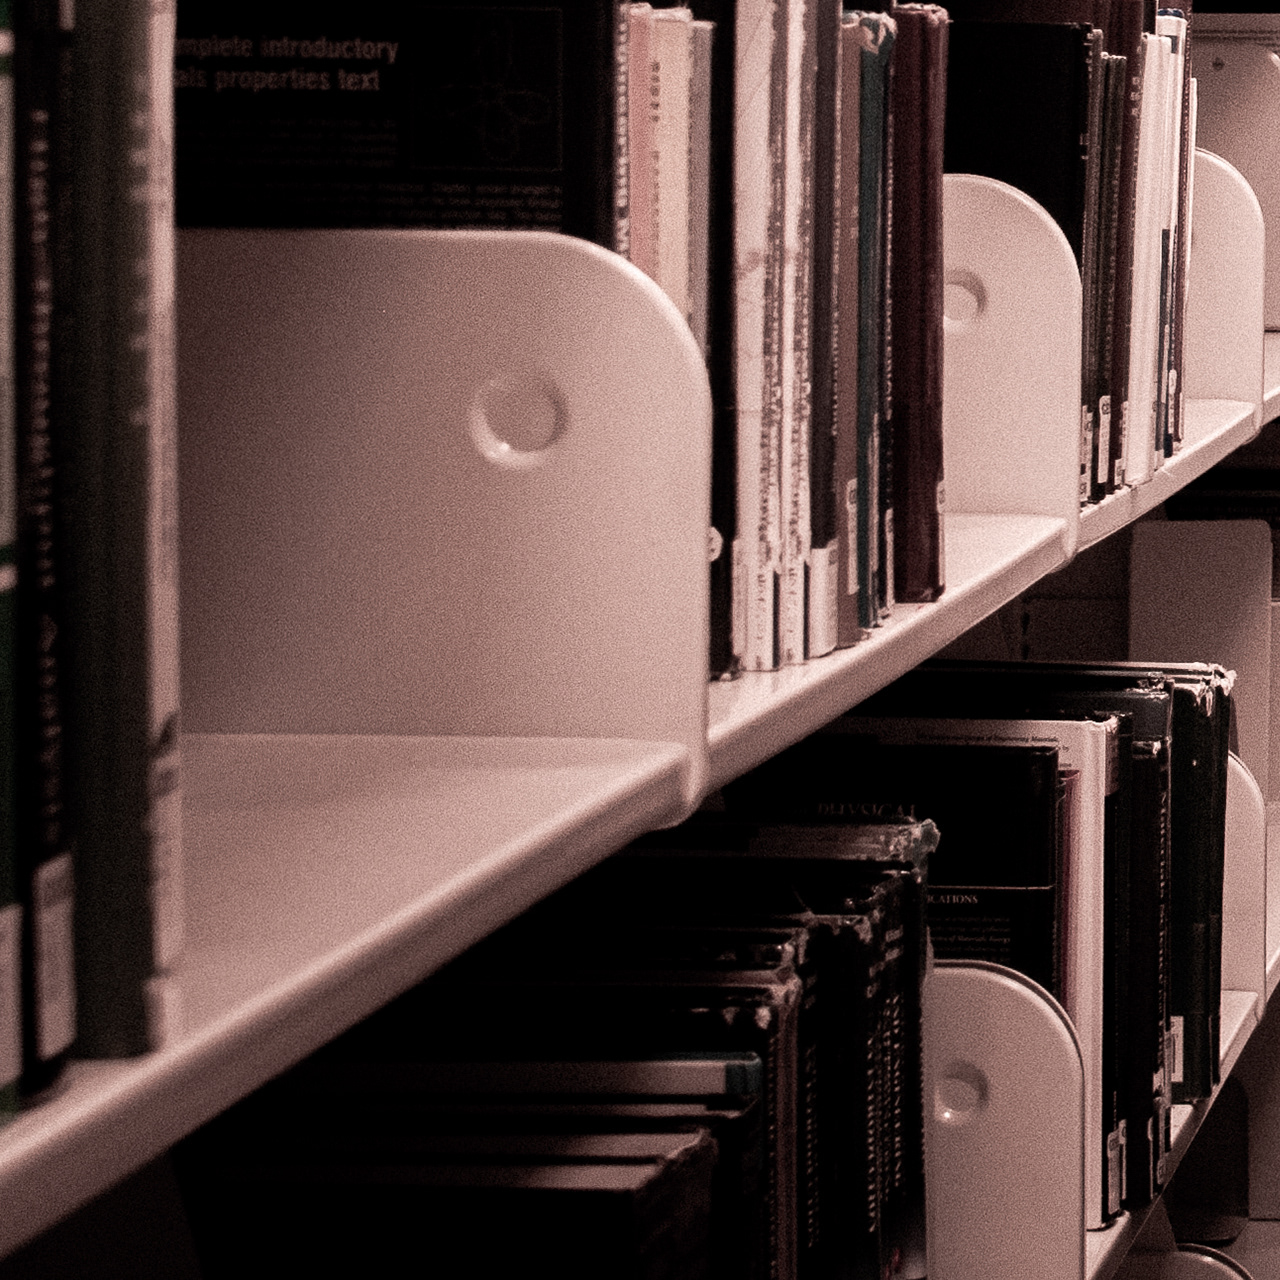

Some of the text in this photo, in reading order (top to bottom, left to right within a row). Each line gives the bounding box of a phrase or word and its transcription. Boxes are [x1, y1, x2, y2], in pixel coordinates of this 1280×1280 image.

[176, 34, 400, 66] mplete introductory
[215, 66, 331, 95] properties
[337, 67, 381, 91] text
